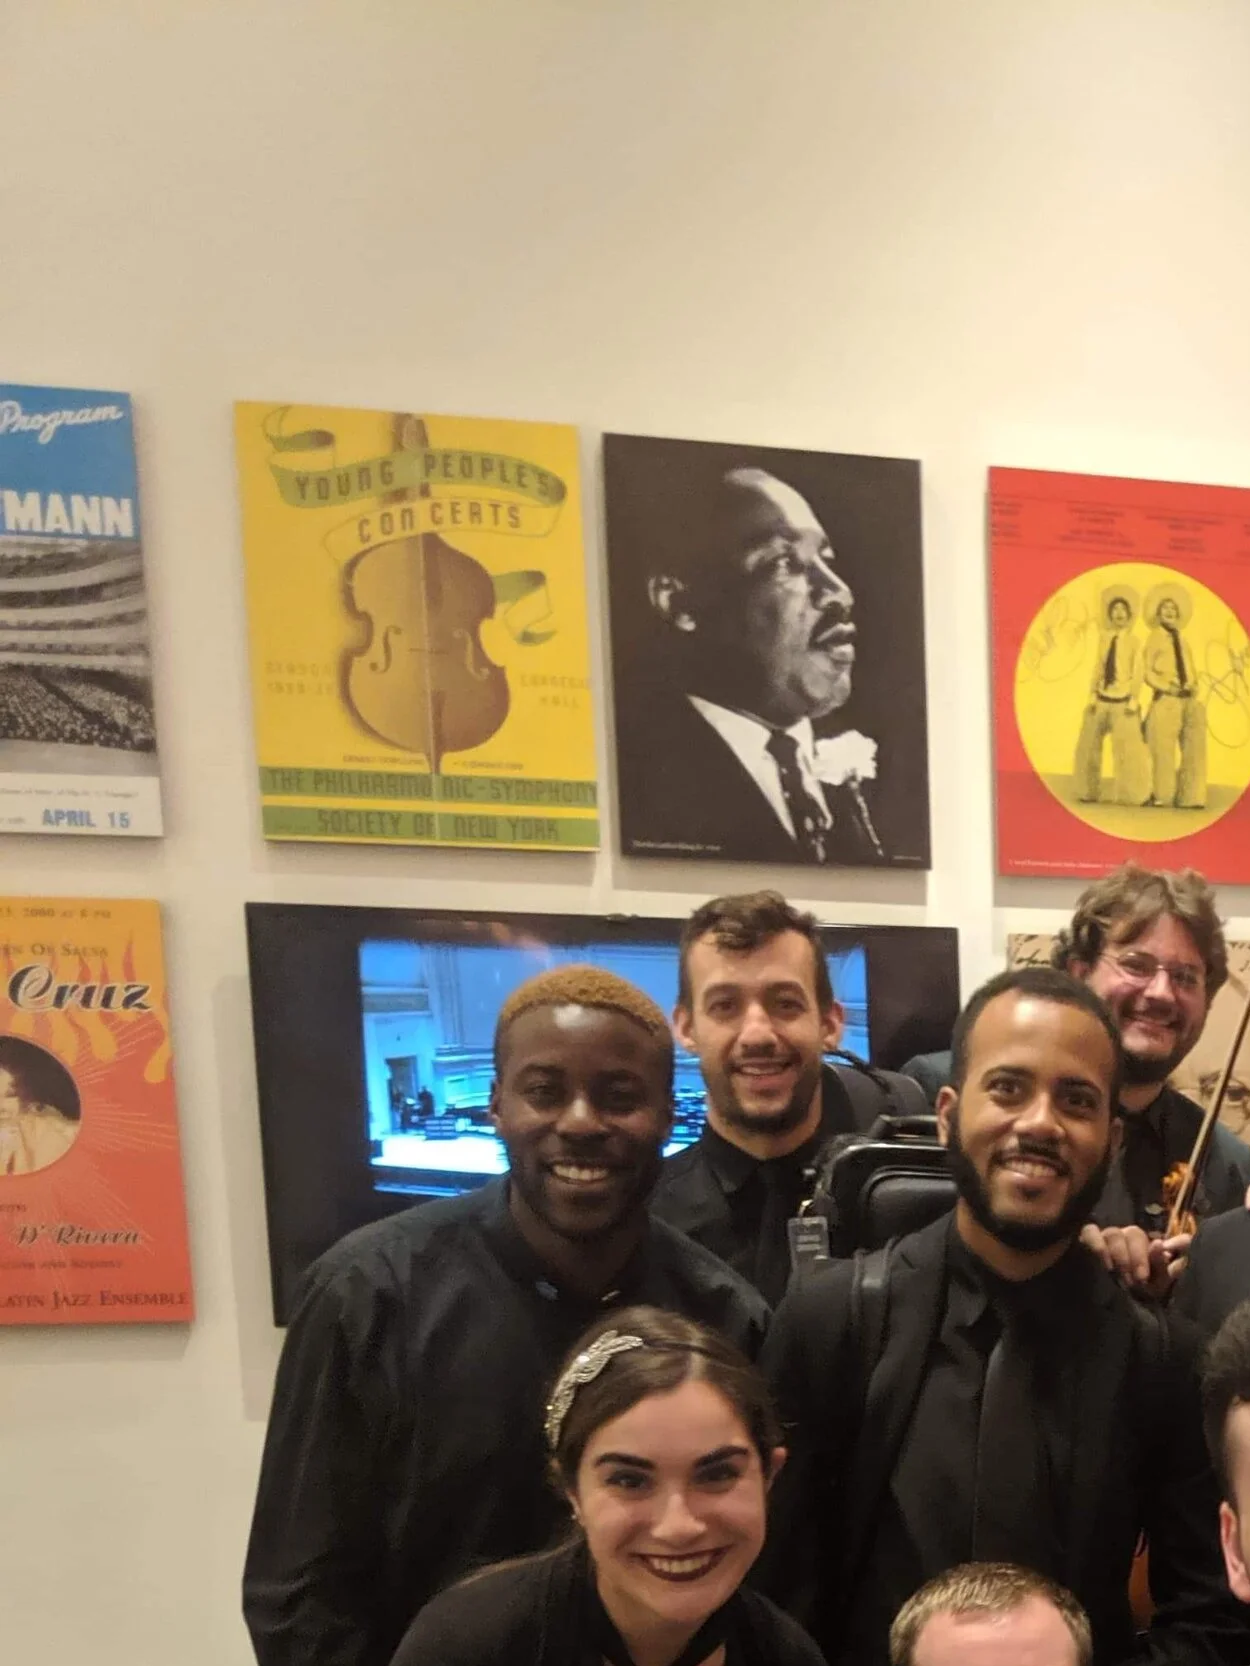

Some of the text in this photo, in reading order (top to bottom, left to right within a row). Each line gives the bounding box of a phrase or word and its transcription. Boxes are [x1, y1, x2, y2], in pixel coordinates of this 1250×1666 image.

[0, 401, 123, 444] Program
[295, 460, 395, 501] YOUNG
[4, 490, 134, 537] MANN
[43, 809, 96, 828] APRIL
[108, 811, 132, 829] 15
[318, 810, 401, 836] SOCIETY
[453, 816, 500, 838] NEW
[508, 818, 560, 841] YORK
[8, 963, 153, 1010] Cruz
